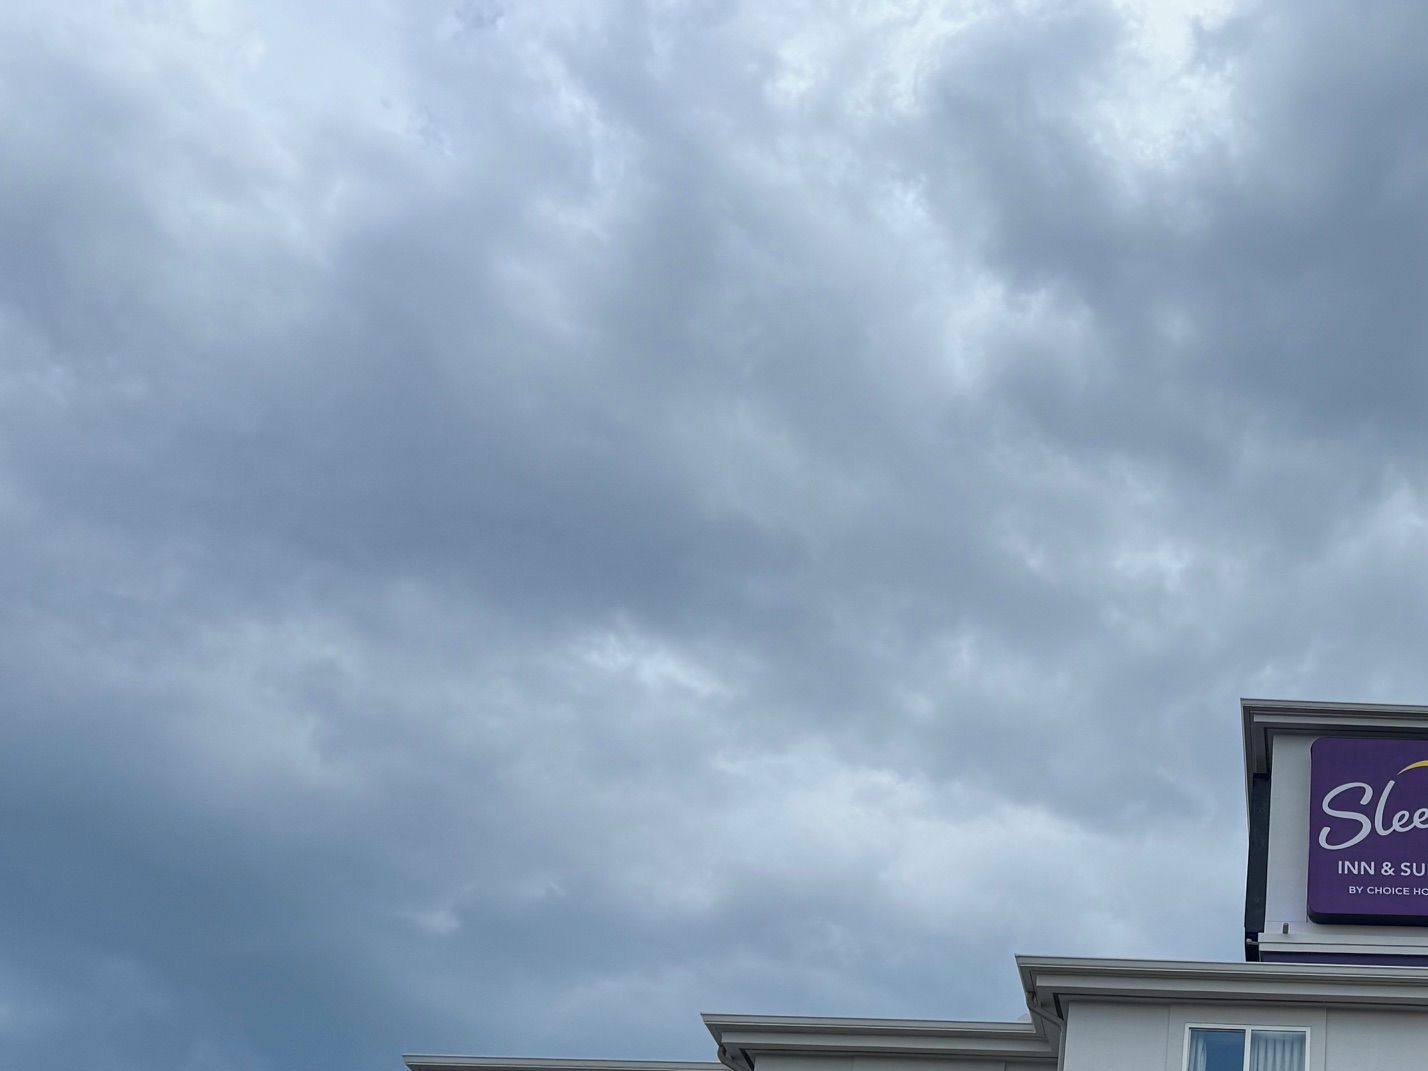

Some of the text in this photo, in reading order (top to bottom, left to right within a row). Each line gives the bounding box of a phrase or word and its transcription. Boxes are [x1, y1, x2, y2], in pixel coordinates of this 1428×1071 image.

[1338, 861, 1375, 875] INN
[1381, 862, 1395, 876] &
[1349, 886, 1364, 894] BY
[1367, 886, 1410, 896] CHOICE
